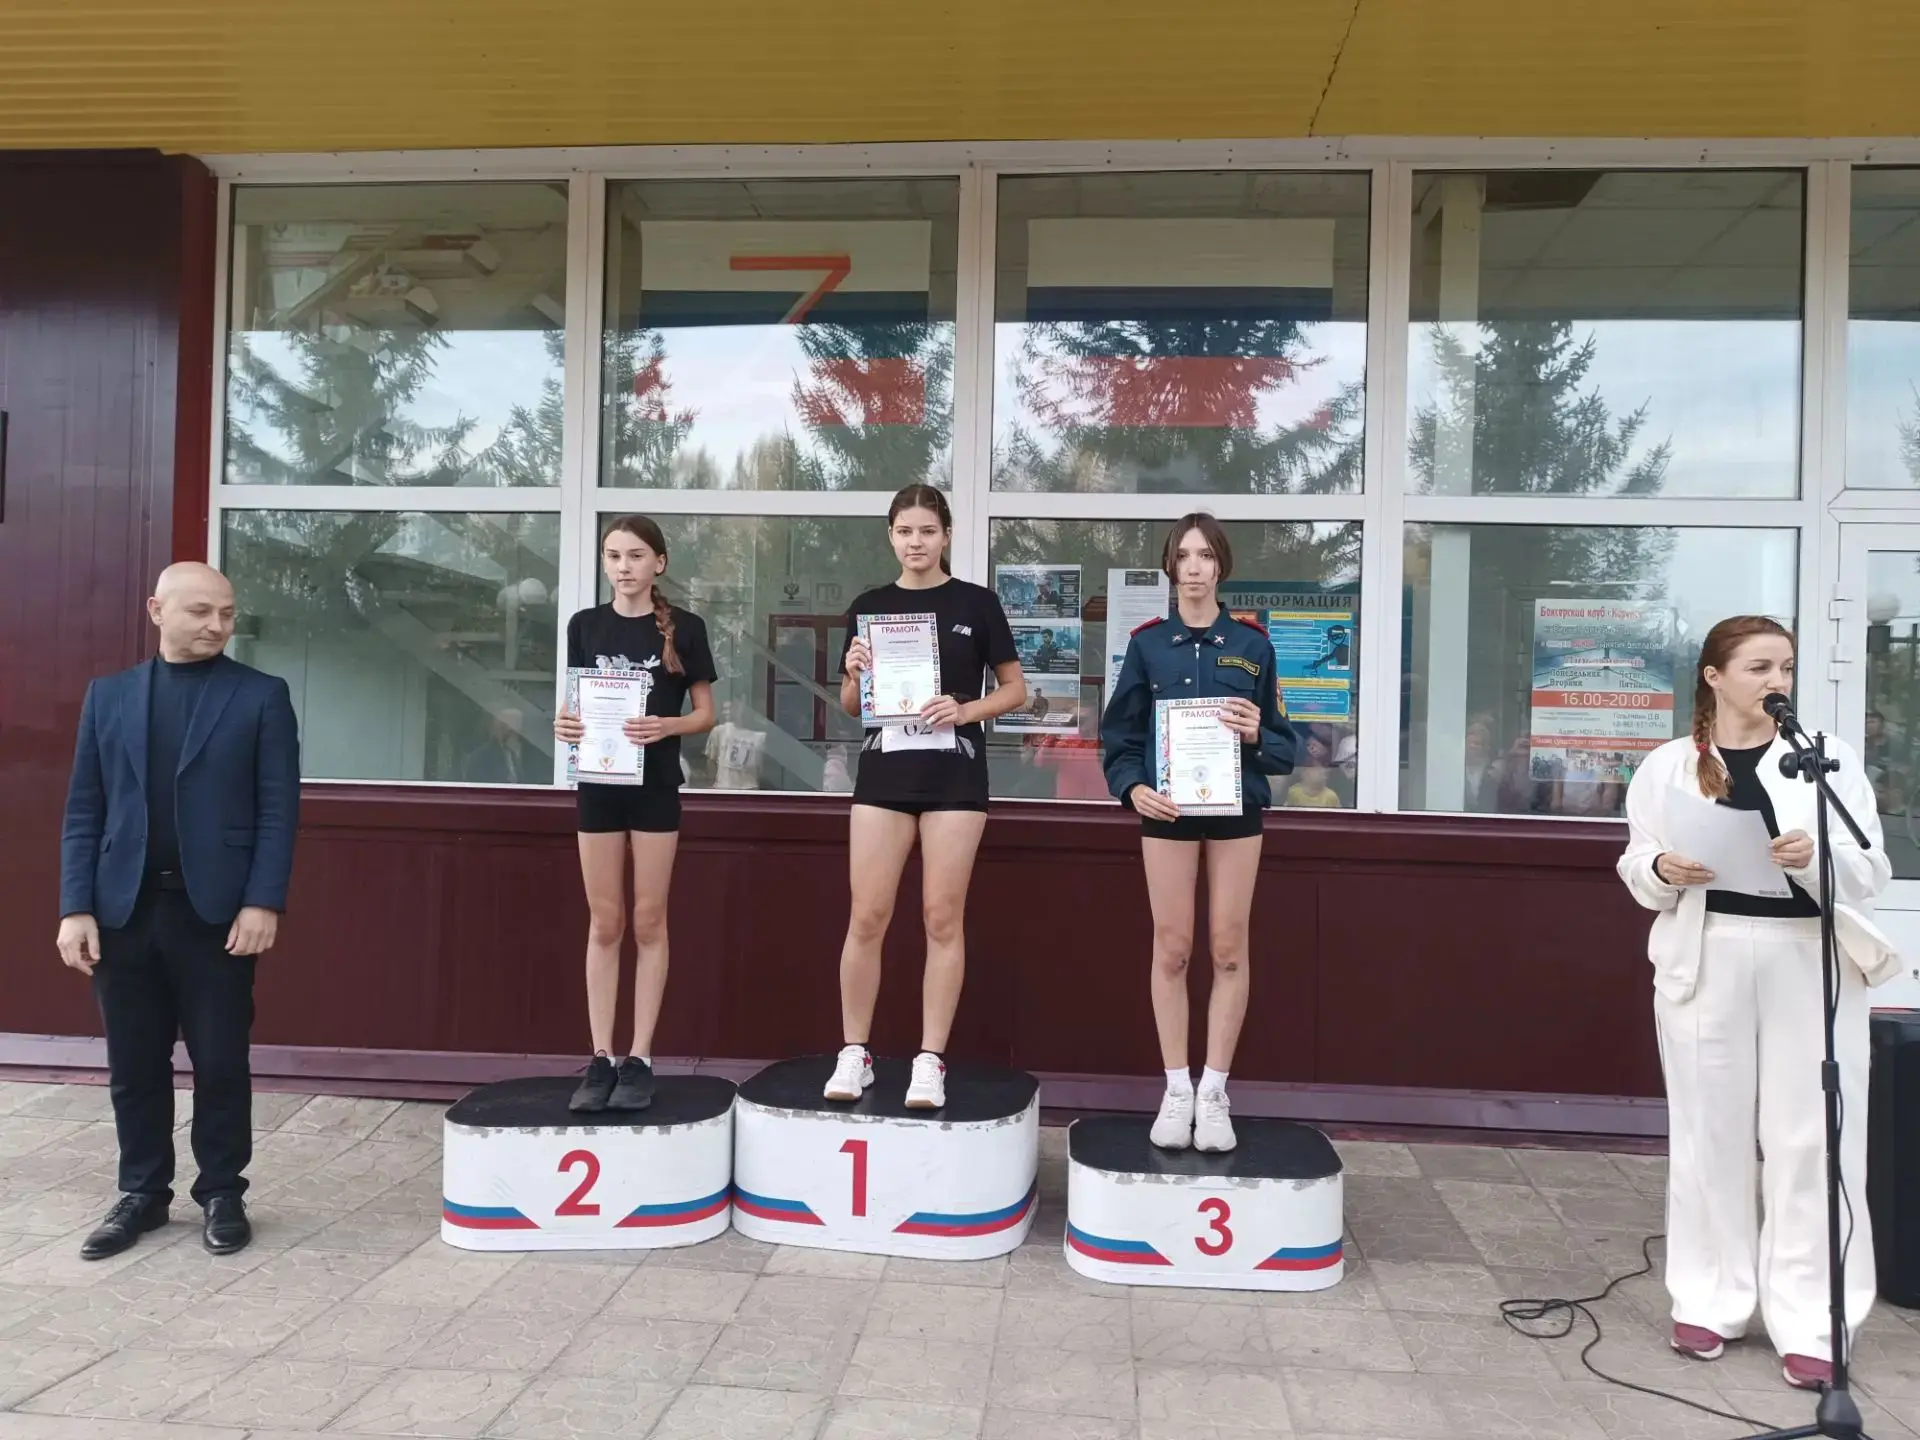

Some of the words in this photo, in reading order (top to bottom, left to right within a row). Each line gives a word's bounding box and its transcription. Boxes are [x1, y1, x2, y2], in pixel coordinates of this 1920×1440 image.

[1232, 594, 1353, 609] ИНФОРМАЦИЯ
[1587, 606, 1606, 620] клуб
[881, 625, 921, 635] ГРАМОТА
[1550, 669, 1602, 679] Понедельник
[589, 680, 631, 690] ГРАМОТА
[1549, 678, 1583, 688] Вторник
[1181, 709, 1221, 718] ГРАМОТА
[555, 1149, 600, 1216] 2
[838, 1139, 868, 1216] 1
[1194, 1197, 1233, 1256] 3
